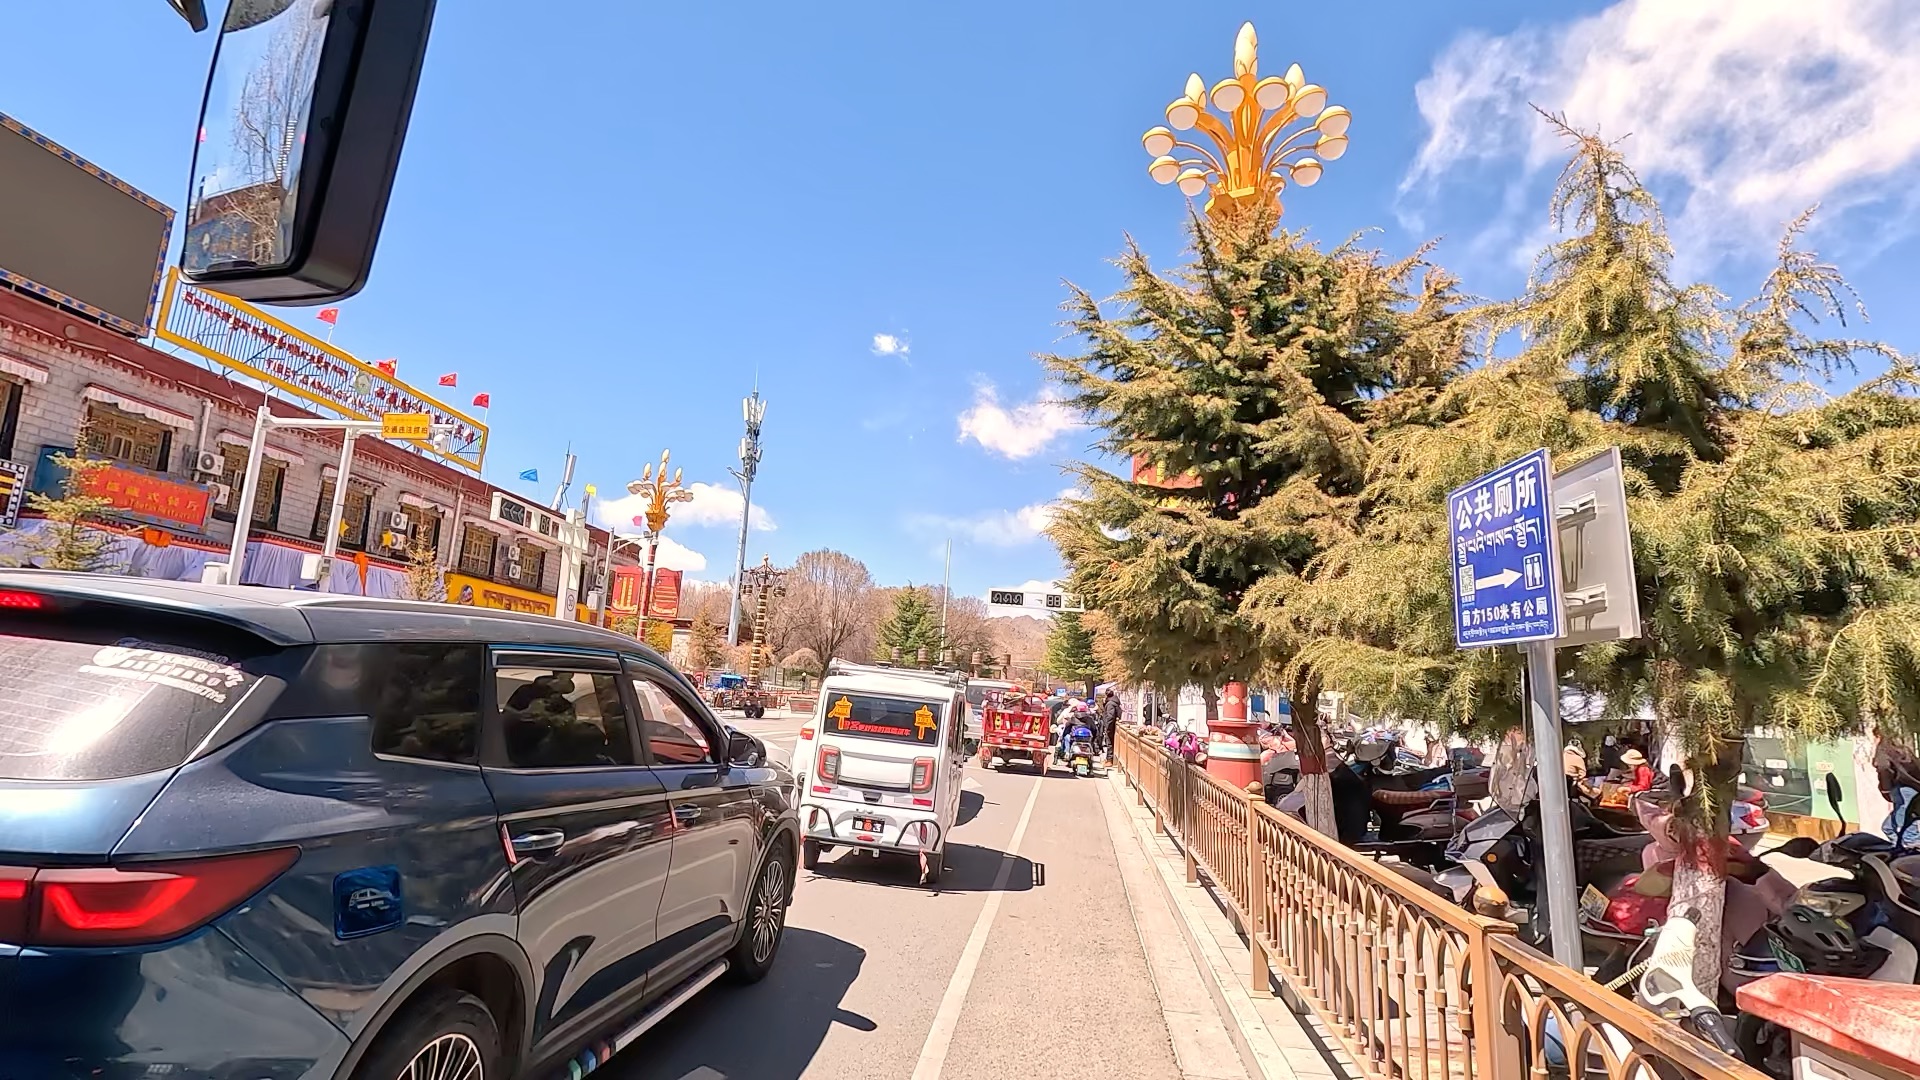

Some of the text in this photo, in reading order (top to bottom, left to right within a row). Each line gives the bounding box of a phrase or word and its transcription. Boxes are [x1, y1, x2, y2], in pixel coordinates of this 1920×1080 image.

[1456, 465, 1536, 532] 公共厕所
[1462, 596, 1548, 627] 前方150米有公厕
